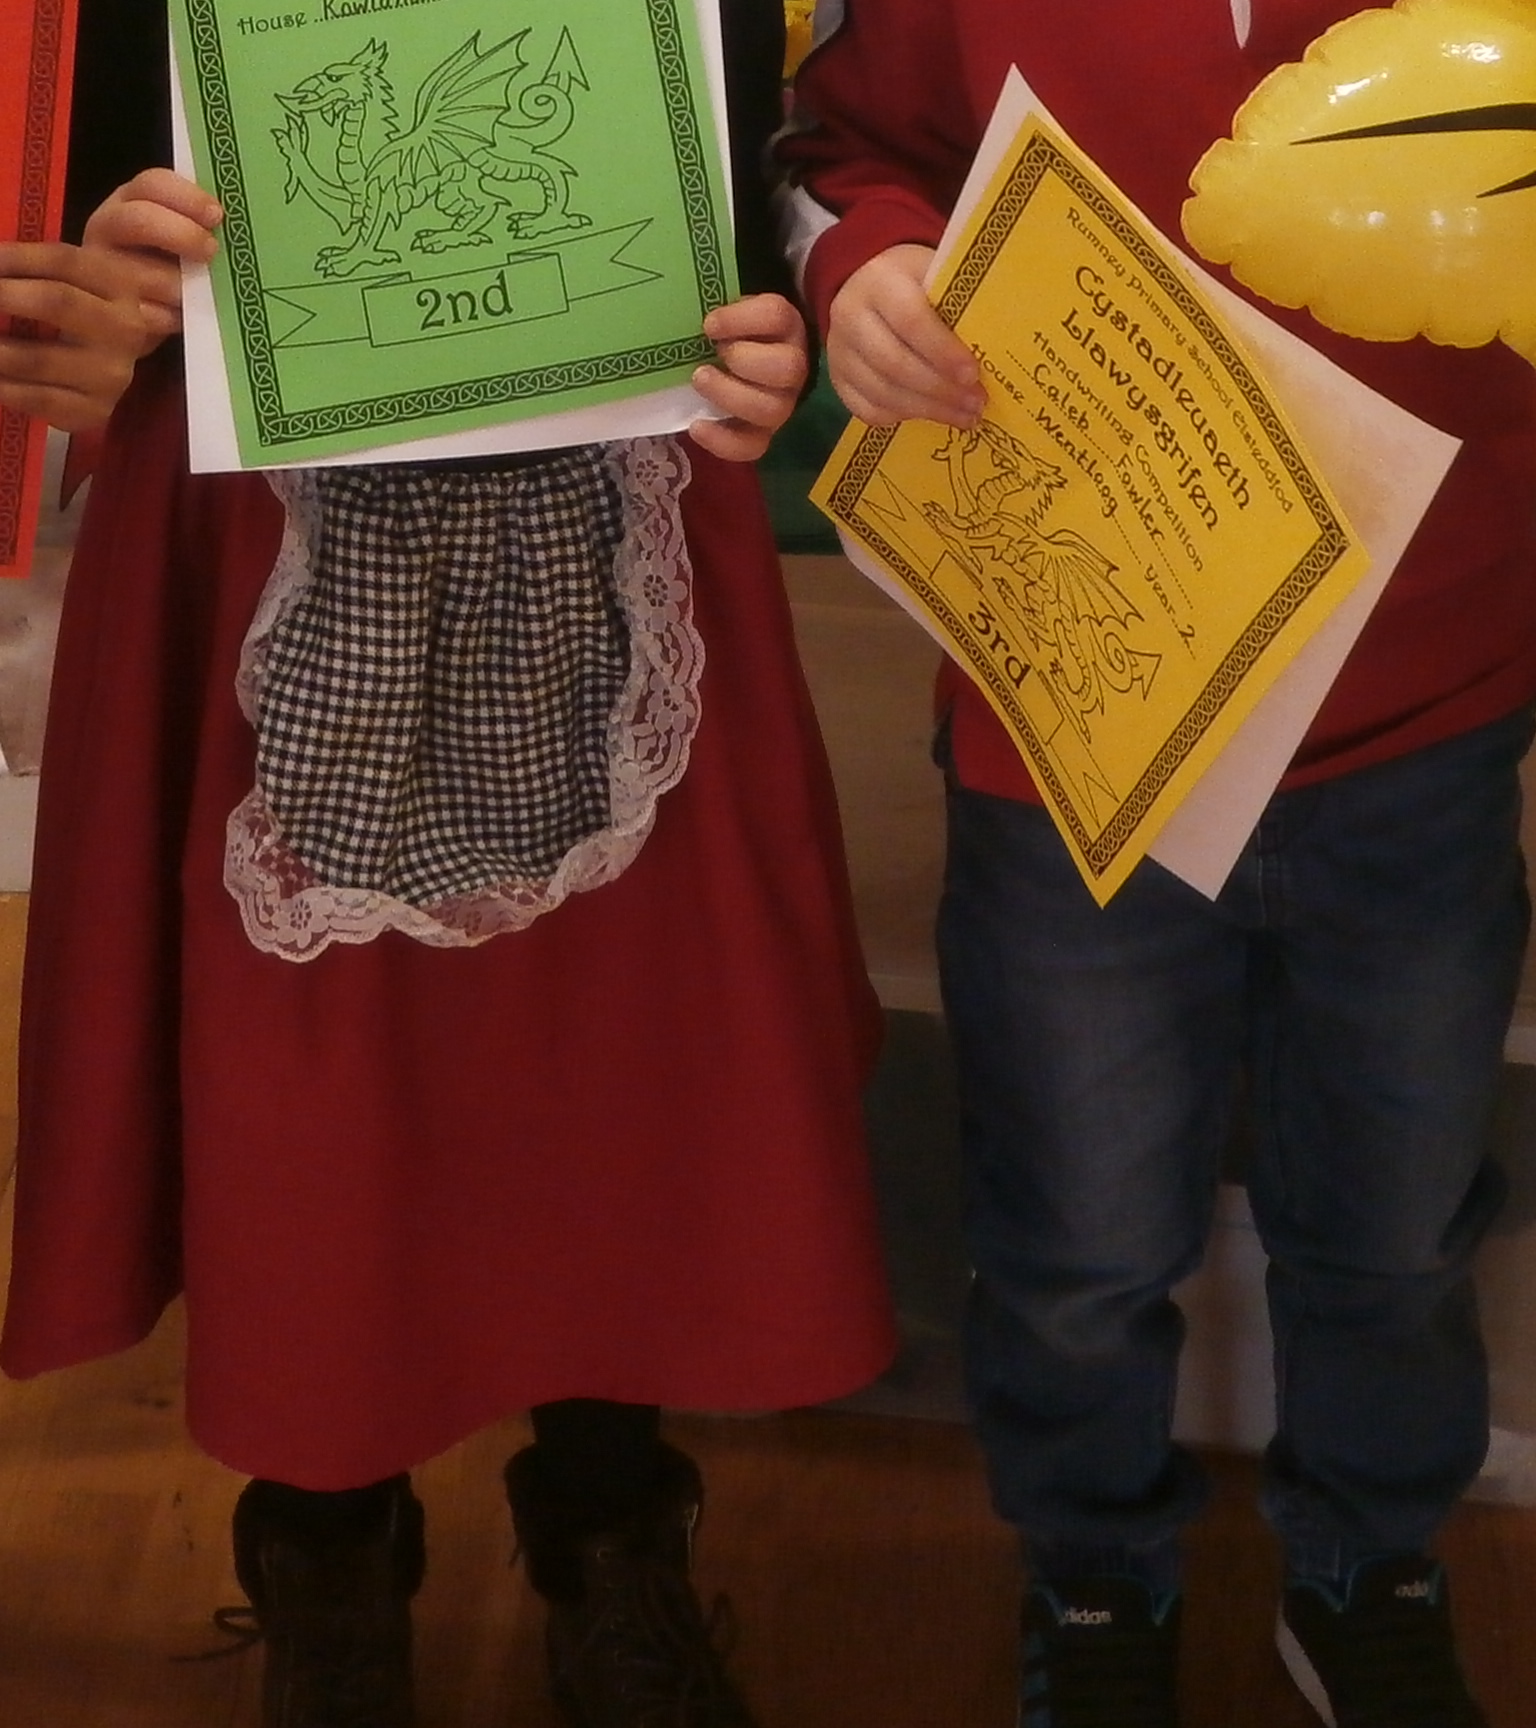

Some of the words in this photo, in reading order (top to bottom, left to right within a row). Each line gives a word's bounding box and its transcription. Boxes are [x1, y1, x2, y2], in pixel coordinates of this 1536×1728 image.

[237, 11, 307, 35] House
[416, 269, 513, 331] 2nd
[1066, 206, 1126, 278] Rumney
[1125, 275, 1187, 347] Primary
[1187, 344, 1234, 410] School
[1231, 409, 1294, 514] Eisteddfod
[1075, 266, 1251, 510] Cystadleuaeth
[971, 343, 1025, 405] House
[1035, 406, 1119, 519] Wentloog
[1144, 563, 1177, 616] Year
[1177, 623, 1197, 645] 2
[1032, 330, 1134, 447] Handwriting
[1134, 444, 1204, 573] Competition
[1033, 362, 1091, 432] Caleb
[1115, 451, 1166, 543] Fowler
[1061, 307, 1219, 532] Llawysgrifen
[968, 601, 1031, 689] 3rd
